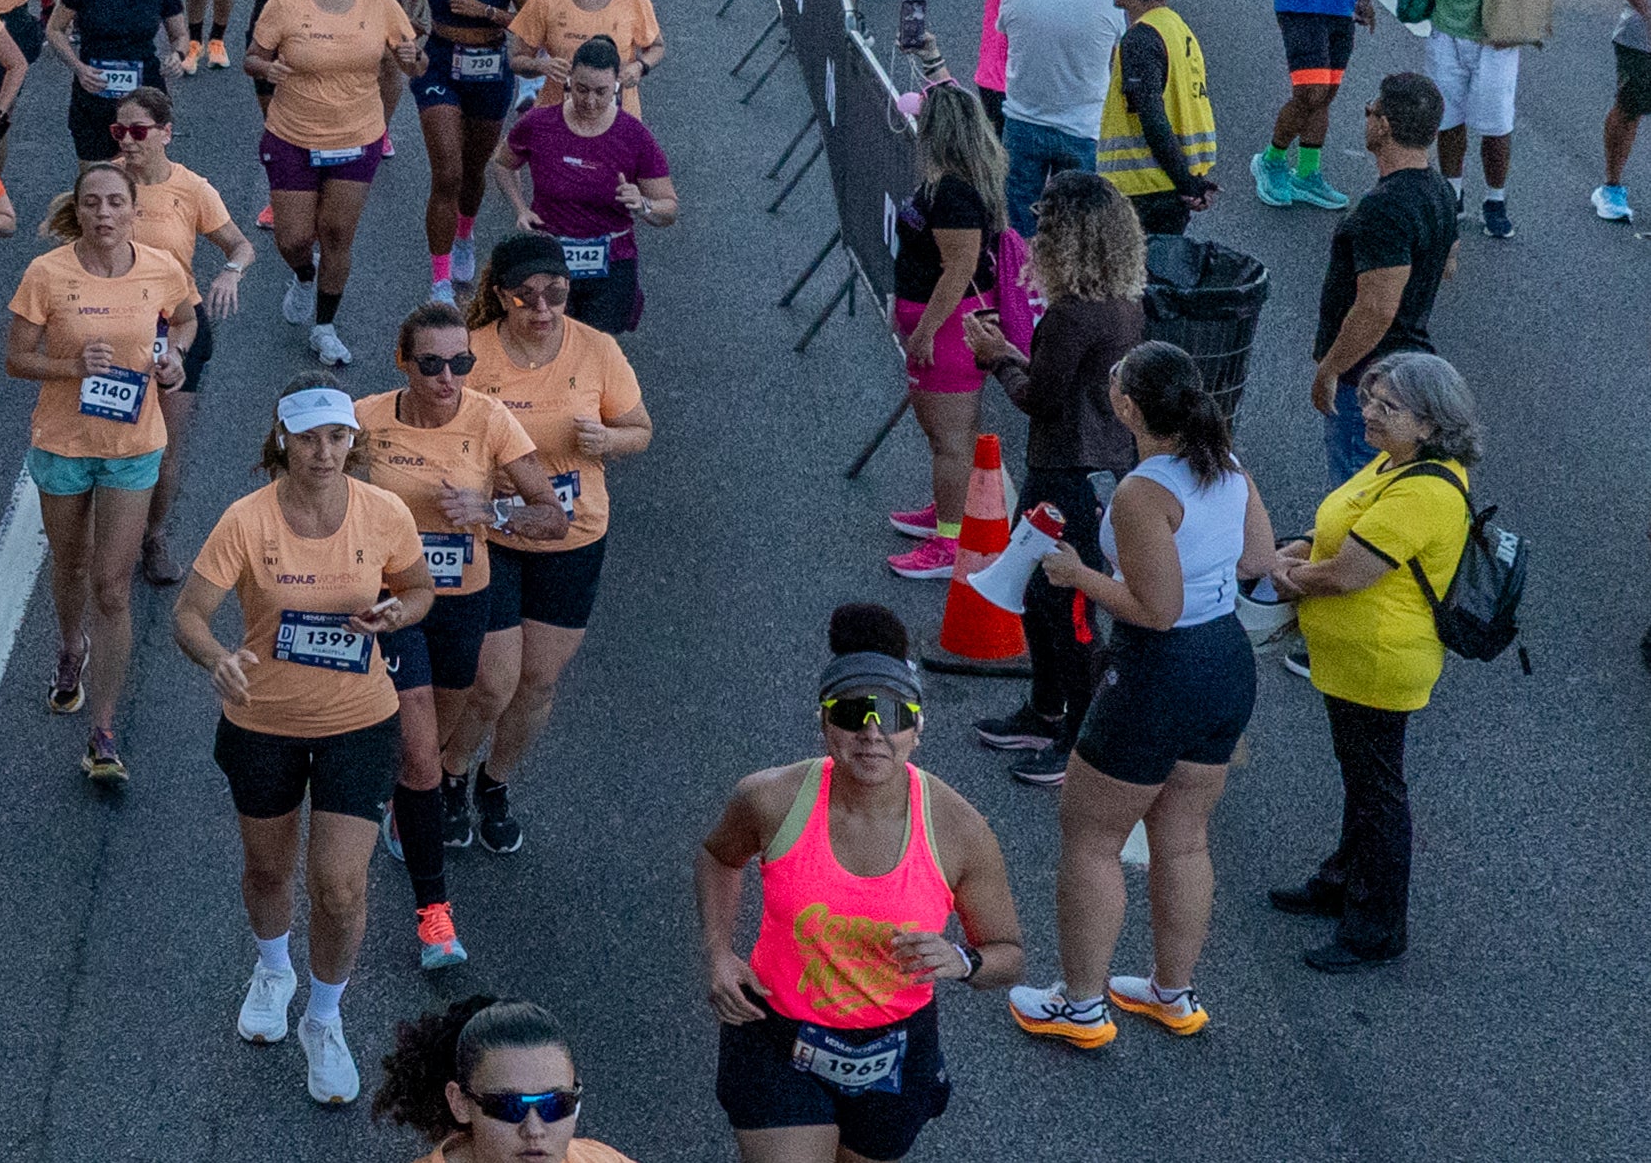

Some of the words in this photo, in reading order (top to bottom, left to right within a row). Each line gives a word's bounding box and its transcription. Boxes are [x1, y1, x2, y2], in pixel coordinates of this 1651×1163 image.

[471, 57, 493, 69] 730
[106, 72, 133, 85] 1974
[565, 249, 600, 262] 2142
[89, 380, 131, 401] 2140
[423, 550, 458, 566] 105
[282, 626, 292, 638] D
[306, 630, 356, 648] 1399
[828, 1057, 888, 1077] 1965
